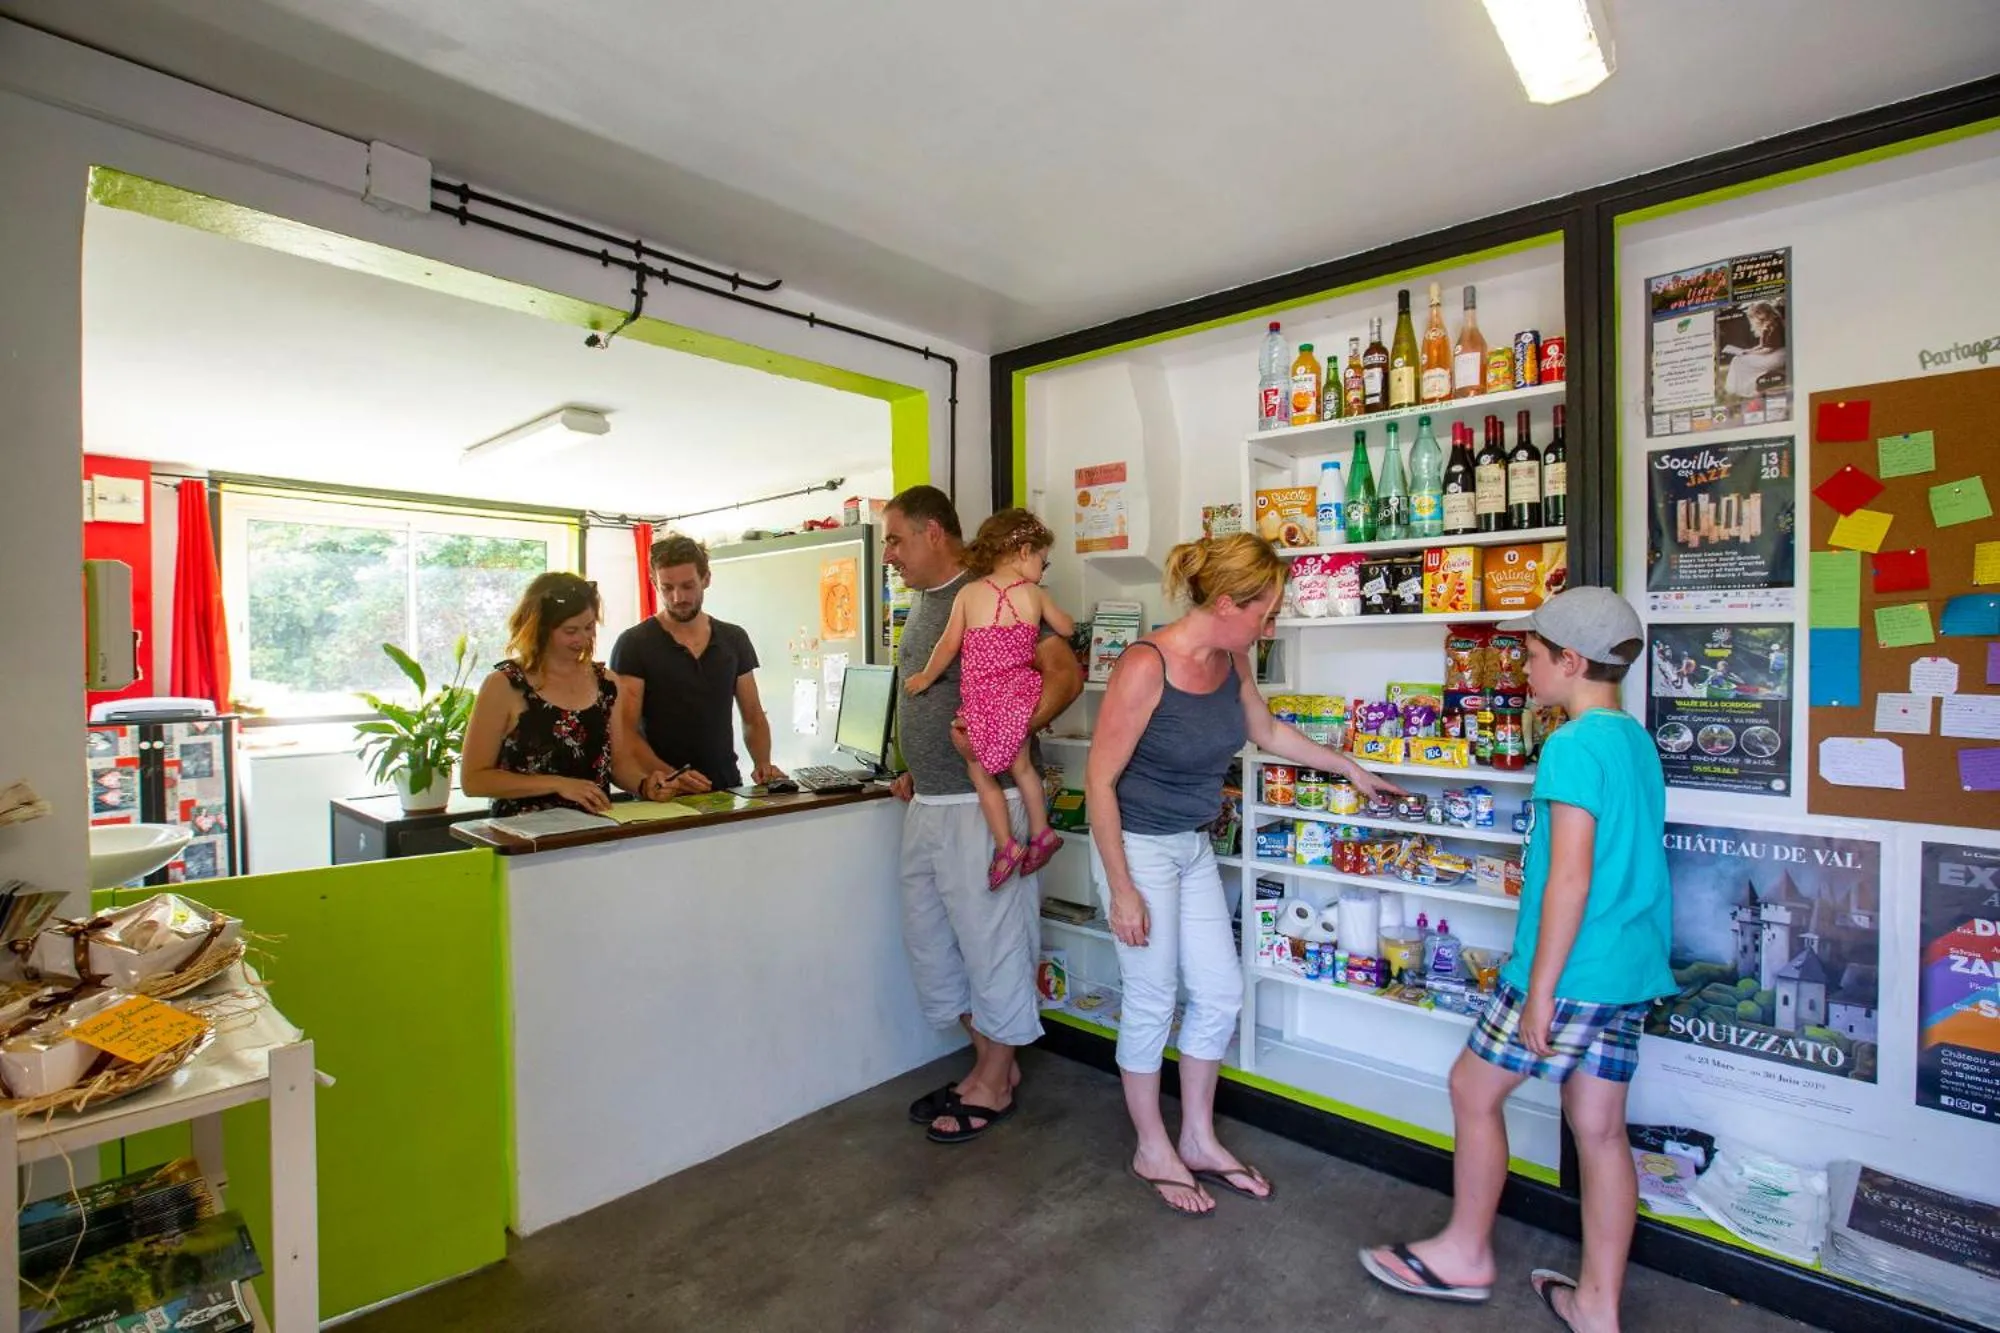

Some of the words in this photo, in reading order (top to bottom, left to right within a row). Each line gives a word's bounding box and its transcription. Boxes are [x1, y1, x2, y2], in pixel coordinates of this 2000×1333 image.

[1761, 452, 1779, 466] 13
[1761, 467, 1780, 479] 20
[1663, 833, 1766, 858] CHÂTEAU
[1773, 845, 1806, 863] DE
[1812, 848, 1862, 869] VAL
[1669, 1013, 1845, 1067] SQUIZZATO
[1941, 1049, 1986, 1064] Château
[1712, 1057, 1735, 1070] Mars
[1778, 1073, 1800, 1086] Juin
